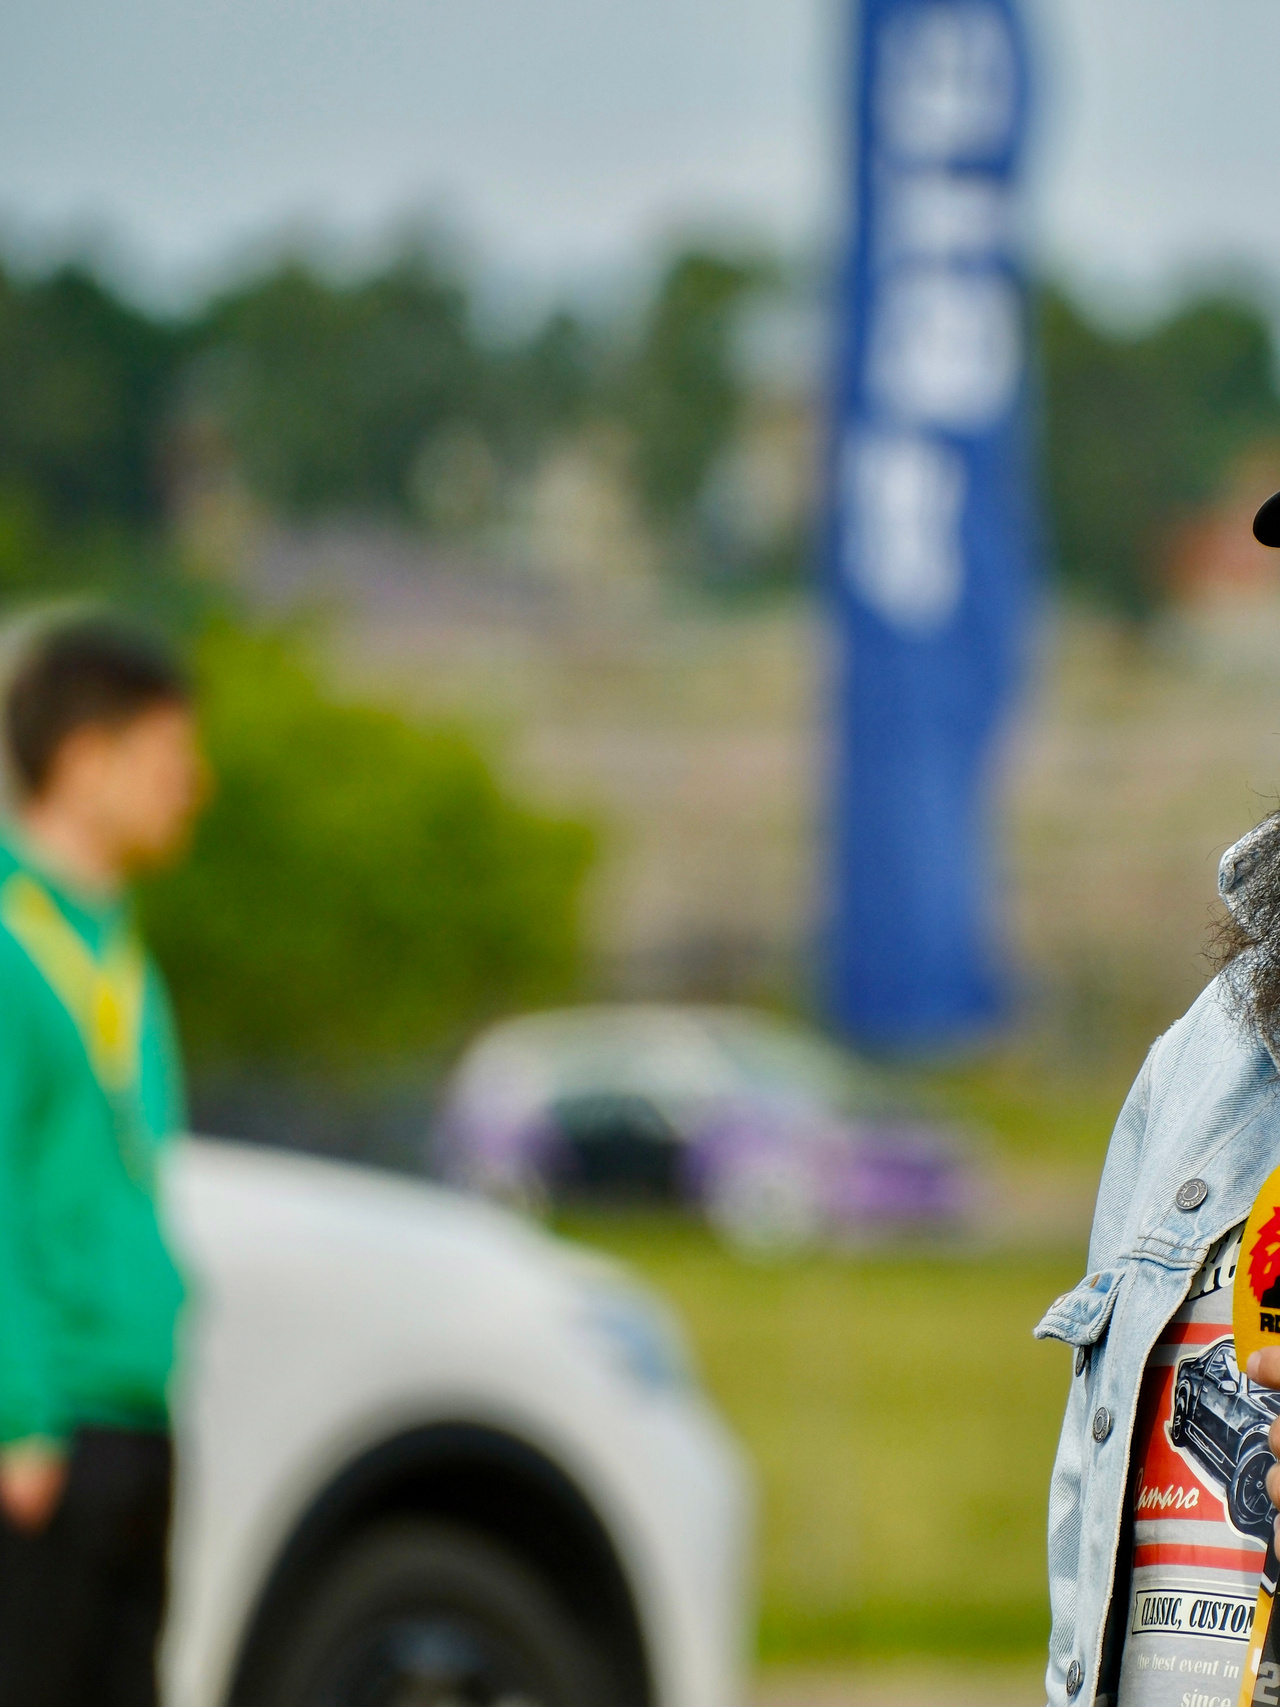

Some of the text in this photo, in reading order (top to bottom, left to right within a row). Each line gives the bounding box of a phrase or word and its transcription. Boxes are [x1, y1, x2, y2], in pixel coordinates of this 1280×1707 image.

[1152, 1653, 1176, 1671] best
[1179, 1657, 1220, 1681] event
[1223, 1660, 1240, 1679] in
